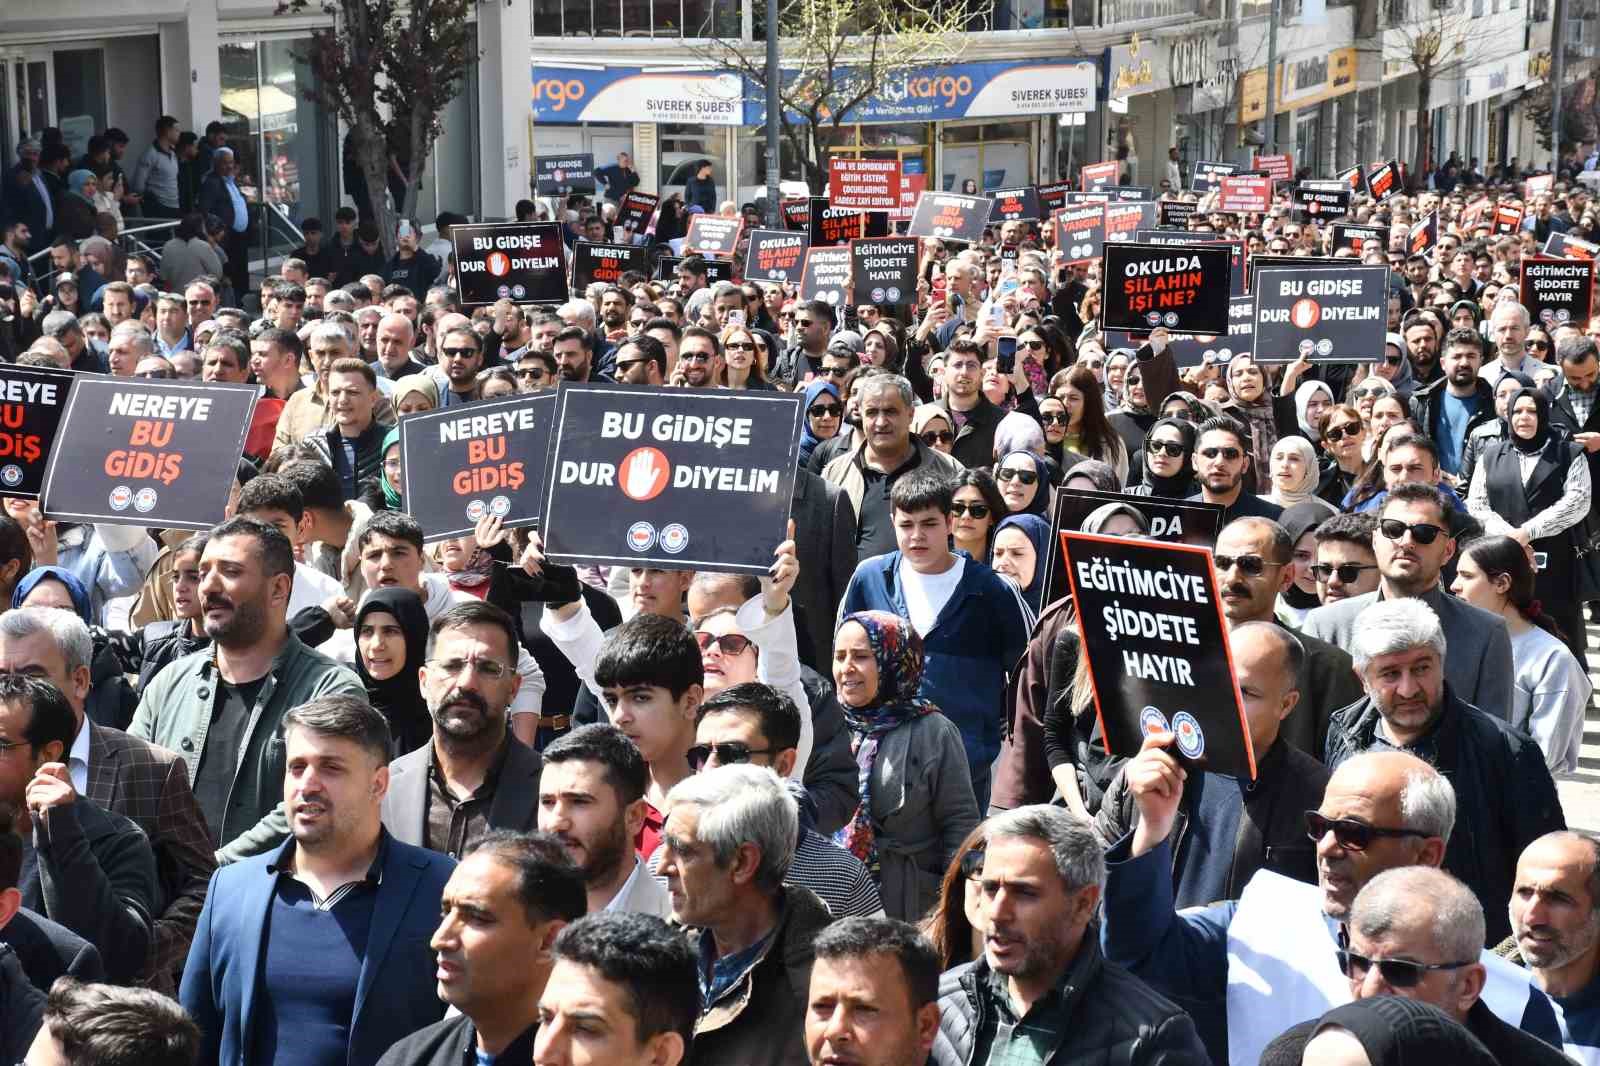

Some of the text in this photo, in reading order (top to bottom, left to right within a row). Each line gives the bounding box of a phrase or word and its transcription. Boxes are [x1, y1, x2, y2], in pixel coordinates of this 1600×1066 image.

[647, 99, 691, 112] SİVEREK
[821, 214, 870, 230] SİLAHN
[473, 234, 542, 250] BU GİDİŞE
[760, 237, 802, 249] OKULDA
[844, 228, 861, 239] NE
[590, 247, 631, 259] NEREYE
[855, 242, 915, 255] EĞİTİMCİYE
[460, 257, 559, 272] DUR DİYELİM
[601, 258, 618, 269] BU
[863, 256, 908, 268] ŞİDDETE
[1125, 255, 1202, 277] OKULDA
[1526, 265, 1589, 277] EĞİTİMCİYE
[869, 270, 901, 280] HAYIR
[1124, 272, 1202, 294] SİLAHIN
[1534, 278, 1580, 291] ŞİDDETE
[1280, 280, 1363, 297] BU GİDİŞE
[1539, 292, 1573, 301] HAYIR
[1129, 290, 1196, 312] İŞİ NE?
[1260, 306, 1380, 323] DUR DİYELİM
[0, 403, 25, 429] U
[109, 392, 213, 421] NEREYE
[129, 420, 175, 448] BU
[439, 407, 535, 443] NEREYE
[601, 411, 753, 449] BU GİDİŞE
[0, 432, 41, 464] DİŞ
[468, 436, 507, 464] BU
[104, 450, 184, 486] GİDİŞ
[559, 461, 780, 494] DUR DİYELİM
[452, 462, 526, 496] GİDİŞ
[1076, 556, 1209, 604] EĞİTİMCİYE
[1102, 600, 1200, 645] ŞİDDETE
[1122, 649, 1196, 687] HAYIR
